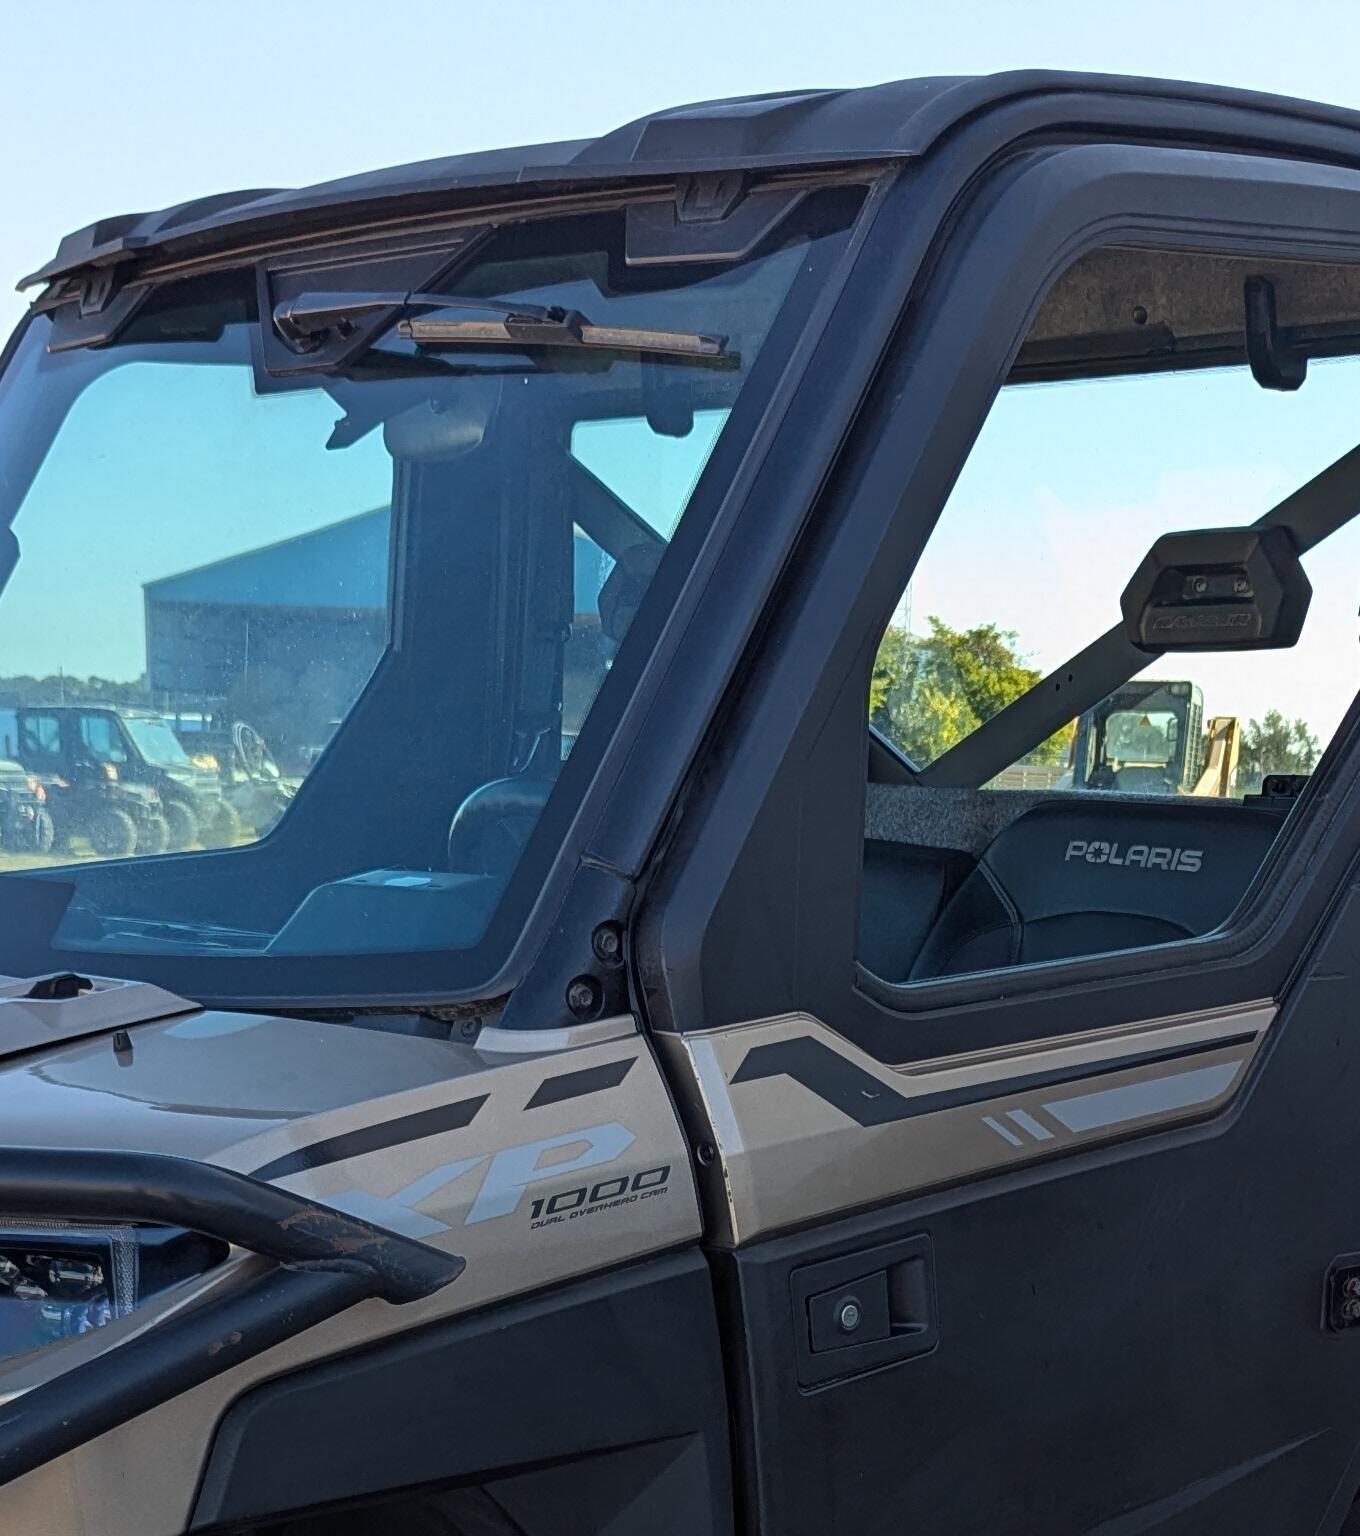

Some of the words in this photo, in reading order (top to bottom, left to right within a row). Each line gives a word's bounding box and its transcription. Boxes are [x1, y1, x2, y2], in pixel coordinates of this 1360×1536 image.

[1064, 840, 1204, 873] POLARIS
[312, 1120, 638, 1241] XP
[530, 1164, 671, 1220] 1000
[530, 1214, 566, 1231] DUAL
[569, 1194, 638, 1220] OVERHEAD
[640, 1186, 669, 1200] CAM
